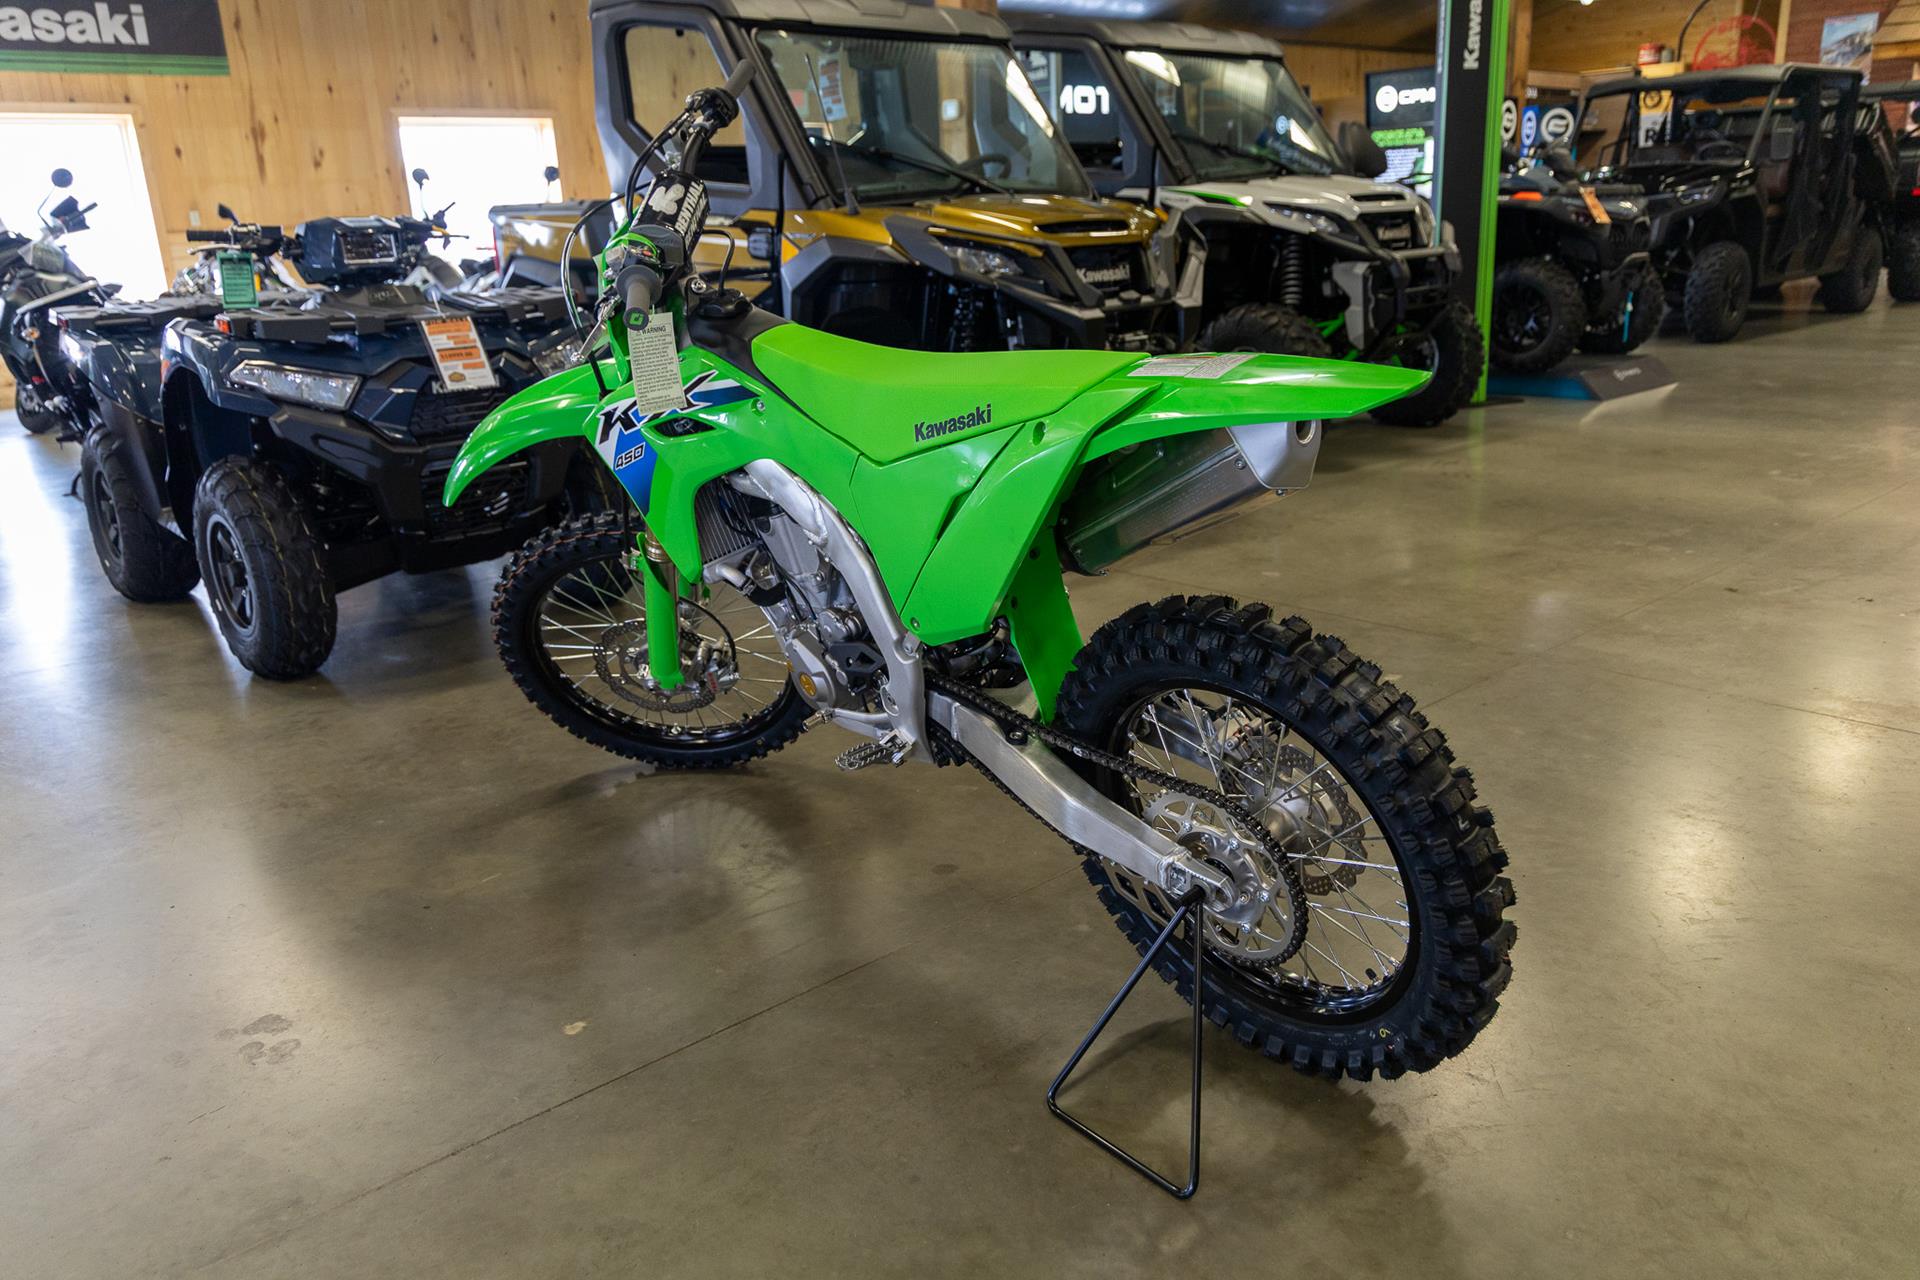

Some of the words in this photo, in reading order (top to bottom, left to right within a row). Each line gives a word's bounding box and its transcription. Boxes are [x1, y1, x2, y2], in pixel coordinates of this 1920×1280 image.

[1076, 264, 1130, 284] Kawasaki
[641, 325, 667, 335] WARNING
[914, 403, 992, 443] Kawasaki
[615, 443, 645, 470] 450
